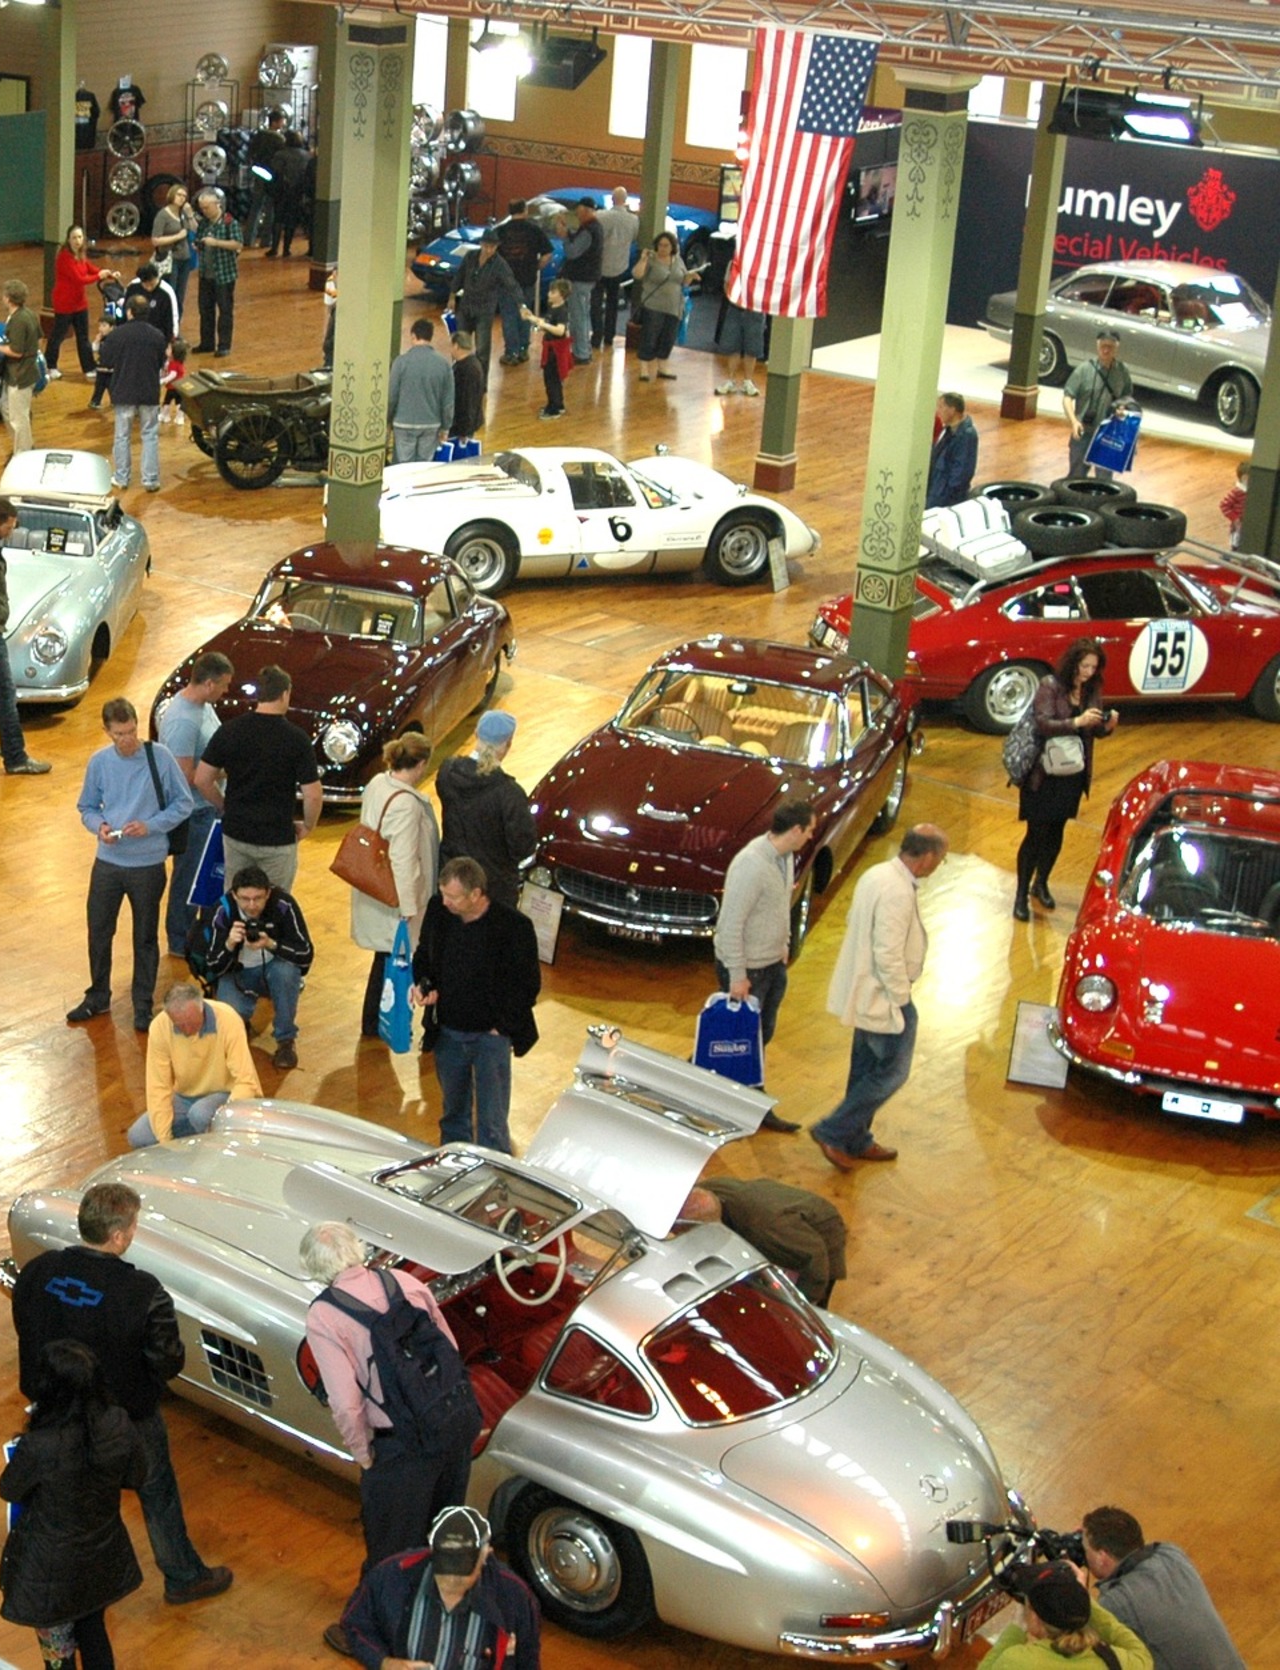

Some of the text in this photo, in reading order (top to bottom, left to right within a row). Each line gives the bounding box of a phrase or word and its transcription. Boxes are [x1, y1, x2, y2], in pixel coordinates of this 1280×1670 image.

[1026, 174, 1182, 239] umley
[608, 516, 633, 542] 6
[1150, 631, 1186, 677] 55
